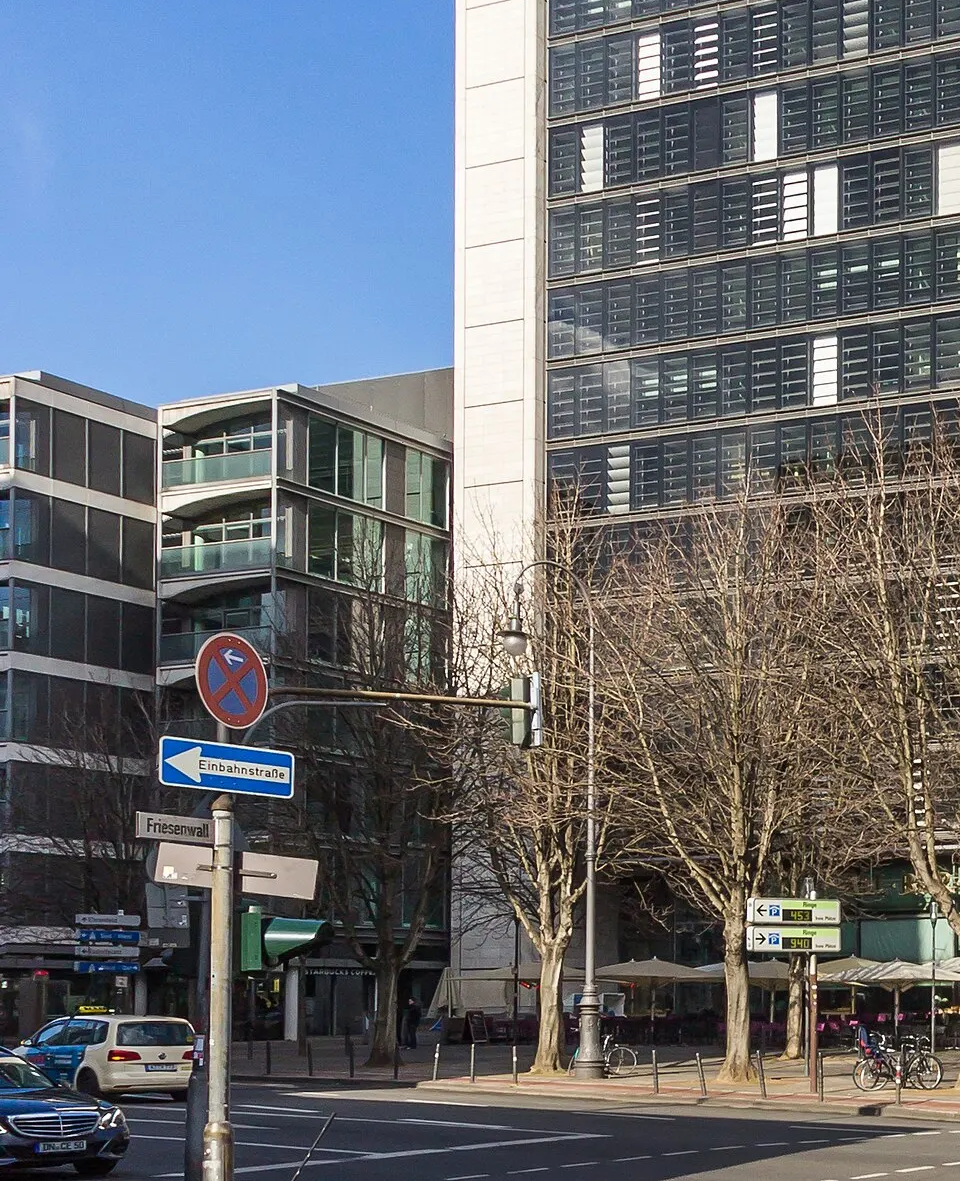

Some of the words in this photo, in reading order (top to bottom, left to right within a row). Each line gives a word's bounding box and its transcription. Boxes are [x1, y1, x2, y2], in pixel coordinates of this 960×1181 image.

[198, 759, 286, 780] Einbahnstraße
[146, 818, 210, 838] Friesenwall
[790, 910, 810, 921] 453
[790, 938, 810, 949] 940
